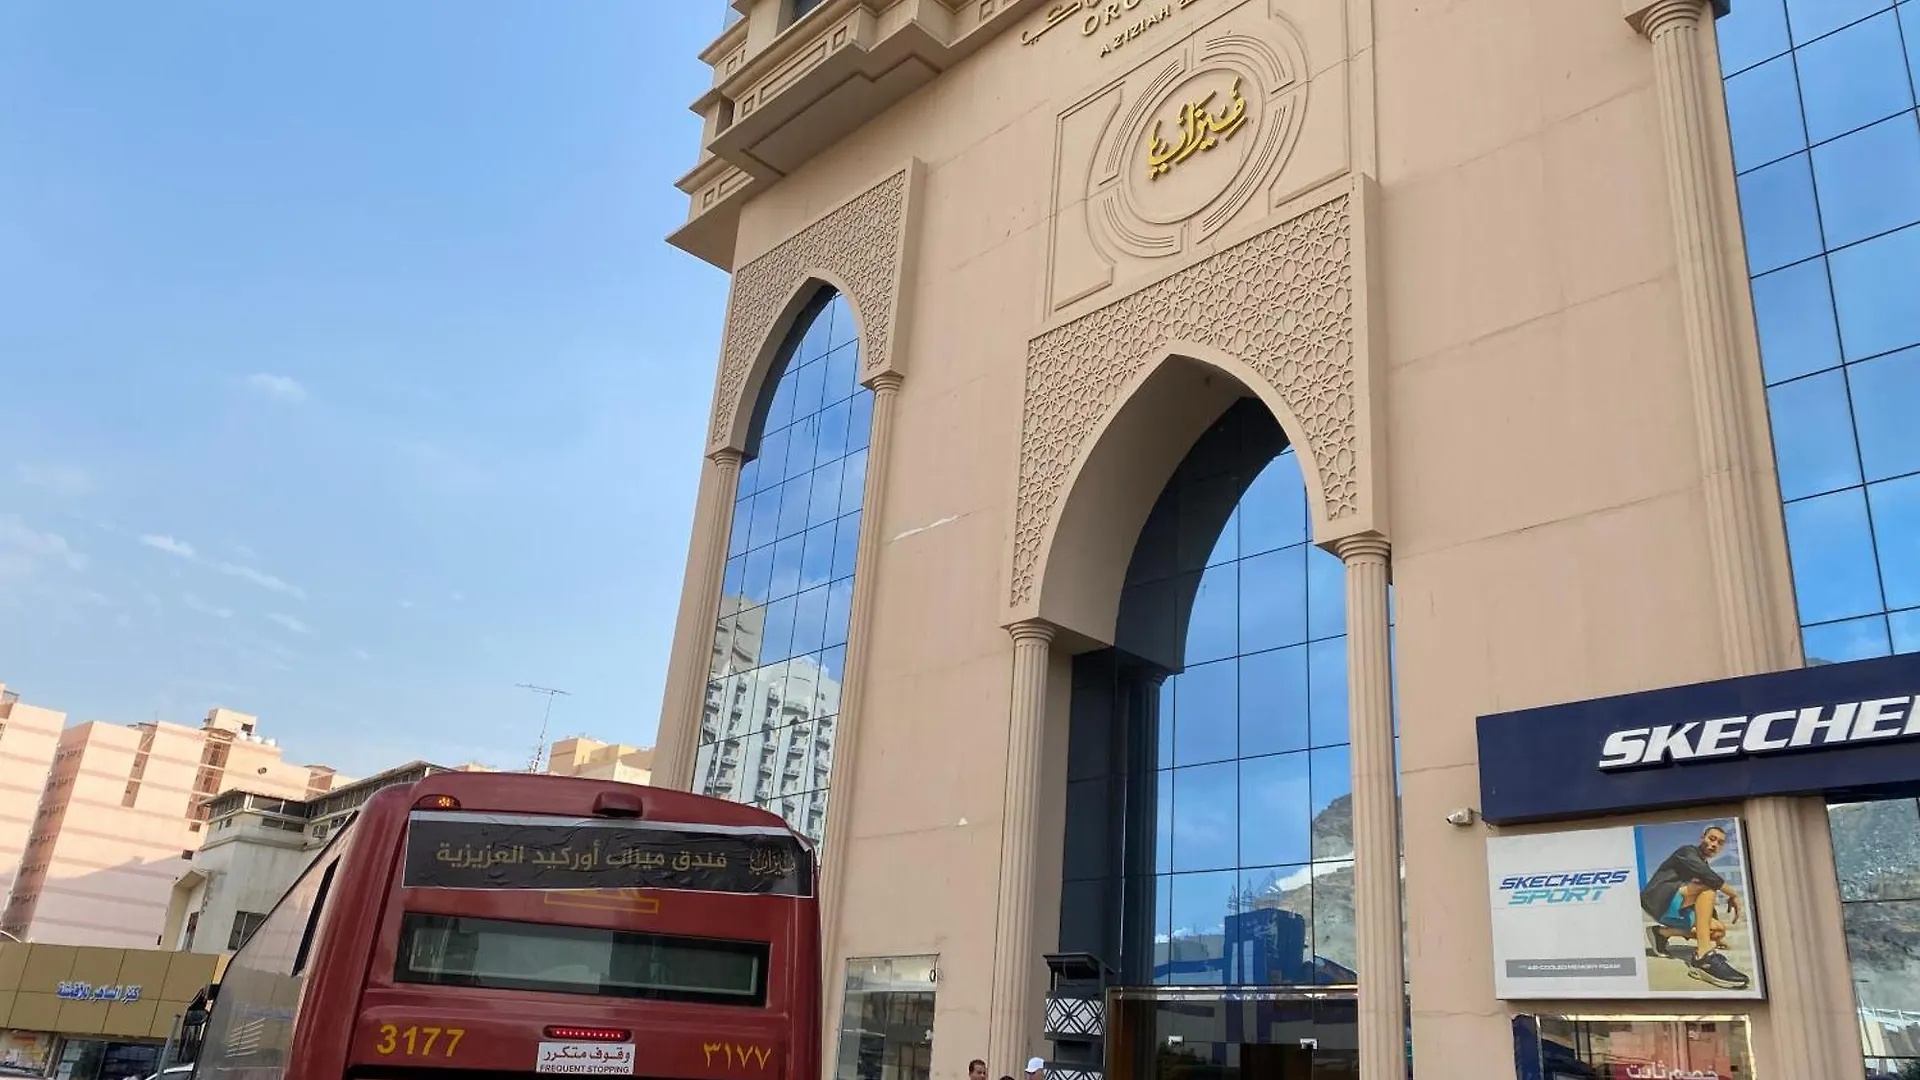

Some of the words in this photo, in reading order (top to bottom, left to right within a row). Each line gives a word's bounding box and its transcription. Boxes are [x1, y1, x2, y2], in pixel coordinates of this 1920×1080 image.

[1100, 4, 1172, 58] AZIZIAH
[435, 842, 525, 870] العزيزية
[532, 839, 601, 871] أوركيد
[672, 850, 727, 872] فندق
[1499, 870, 1630, 890] SKECHERS
[1508, 886, 1611, 905] SPORT
[376, 1023, 465, 1057] 3177
[543, 1046, 586, 1062] متكرر
[590, 1047, 630, 1063] وقوف
[703, 1042, 772, 1070] ٣١٧٧
[539, 1064, 585, 1073] FREQUENT
[586, 1065, 629, 1074] STOPPING
